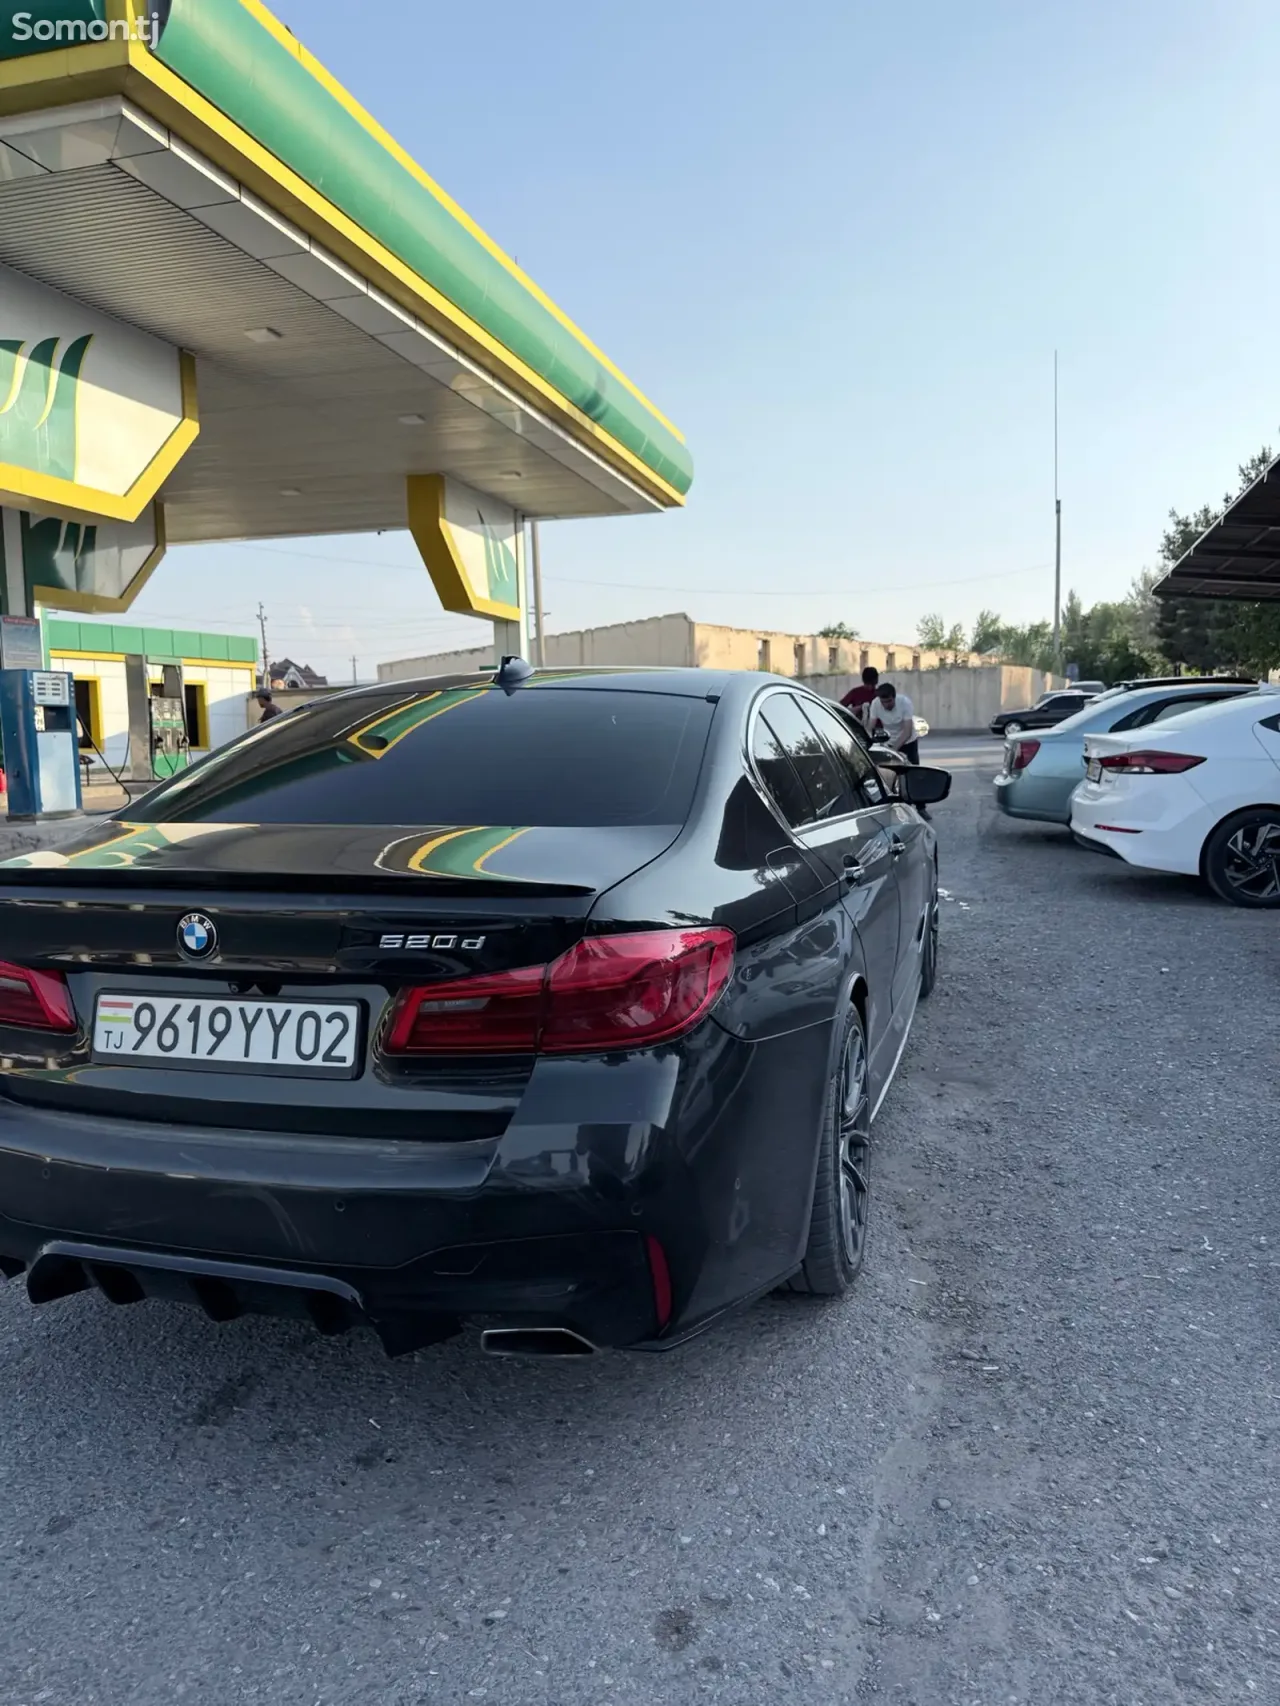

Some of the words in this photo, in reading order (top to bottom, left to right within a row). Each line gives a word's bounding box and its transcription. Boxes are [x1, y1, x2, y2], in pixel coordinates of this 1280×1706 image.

[180, 915, 212, 930] BMW
[104, 1030, 123, 1049] TJ
[131, 1002, 349, 1063] 9619YY02
